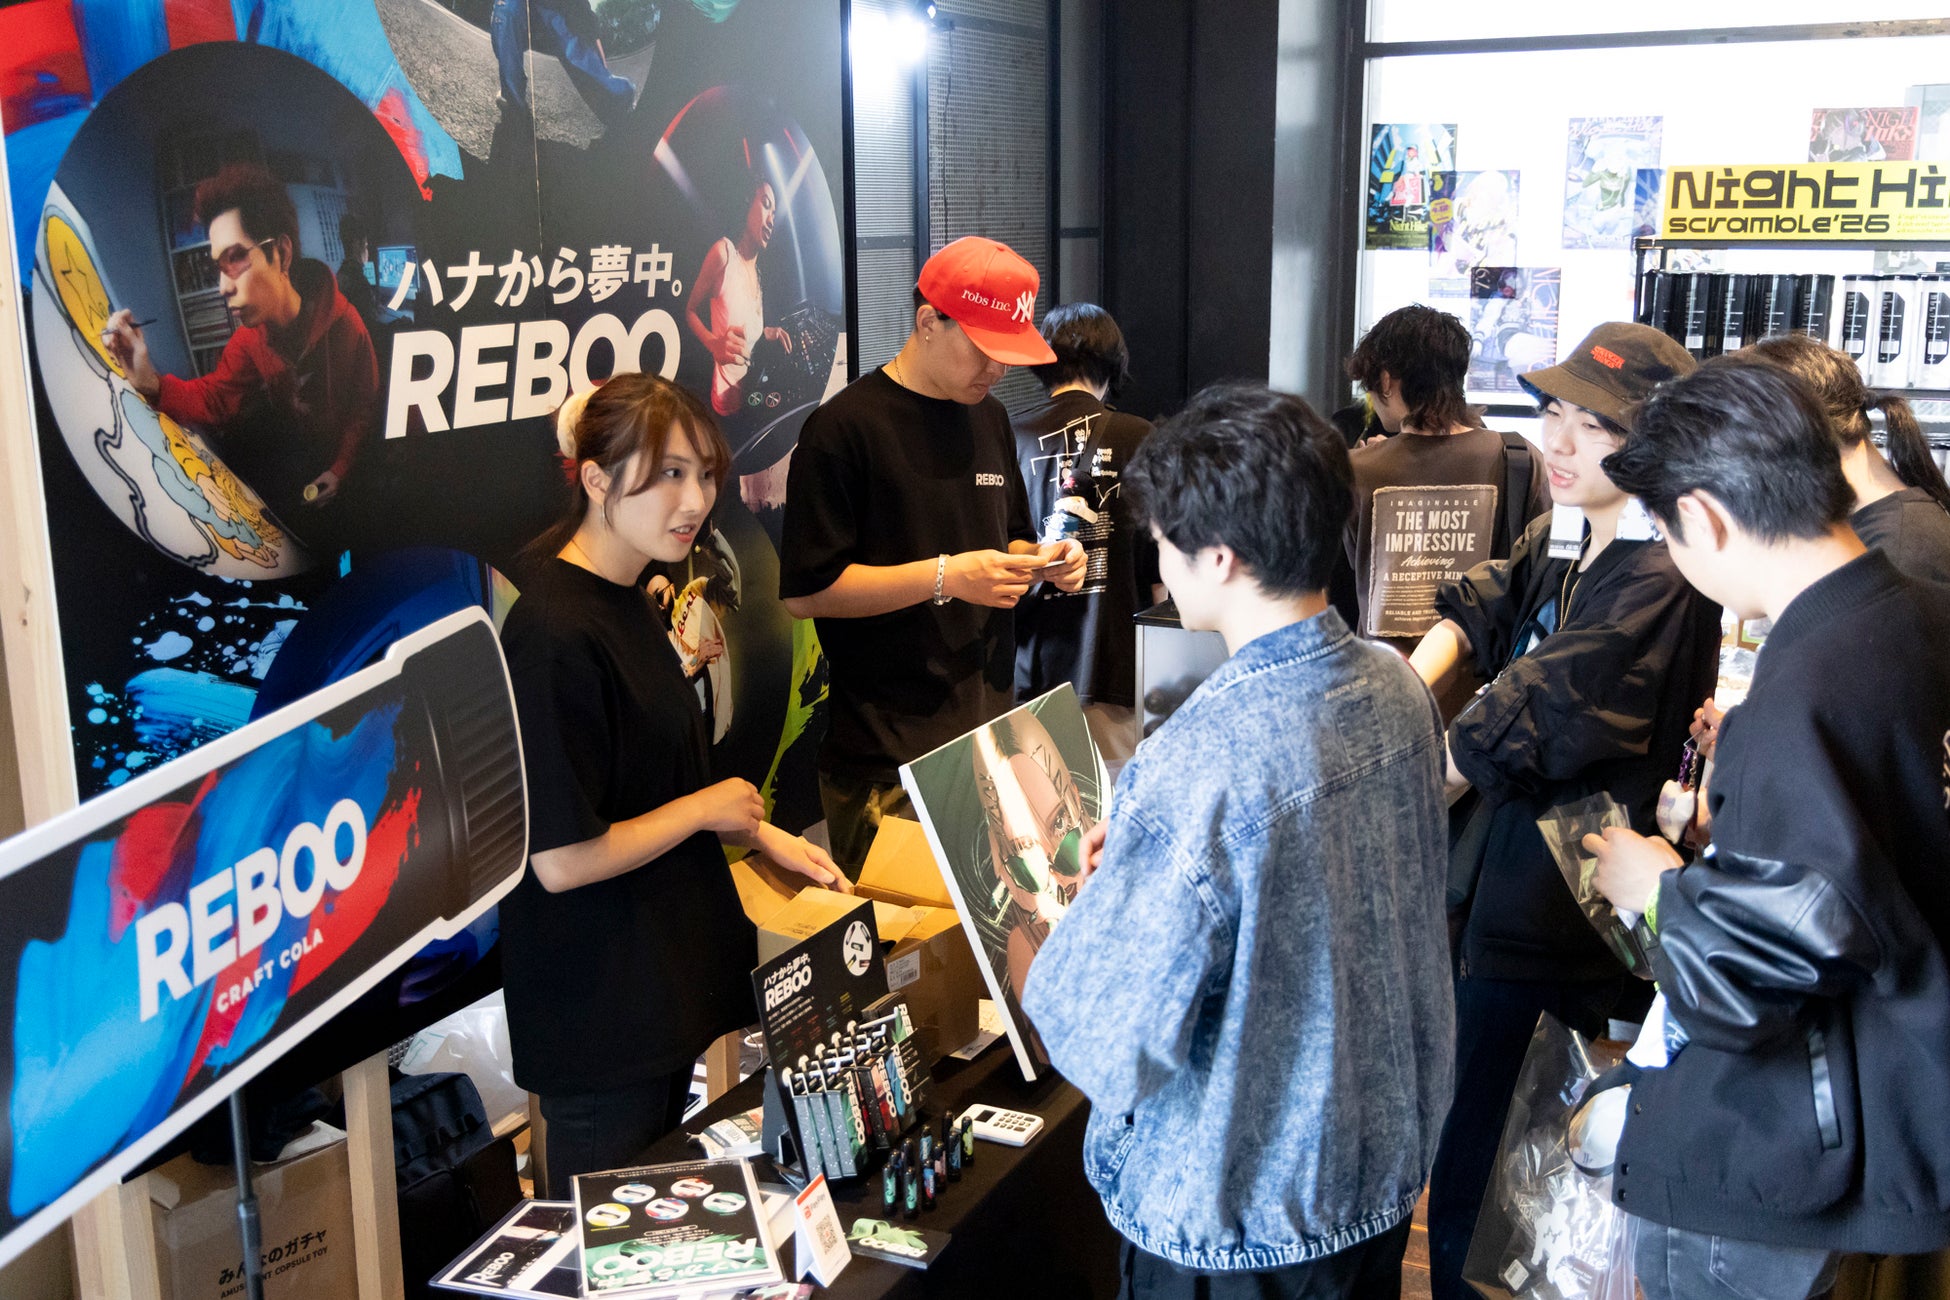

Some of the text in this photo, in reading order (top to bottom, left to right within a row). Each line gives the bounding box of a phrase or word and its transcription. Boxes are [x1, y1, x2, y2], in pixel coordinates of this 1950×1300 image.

[1671, 165, 1950, 209] Night Hi
[1669, 214, 1890, 233] scramble'26
[387, 243, 683, 313] ハナから夢中。
[961, 289, 1011, 311] robs inc.
[975, 473, 1005, 487] REBOO
[1390, 499, 1479, 507] IMAGINABLE
[1396, 510, 1471, 531] THE MOST
[1385, 532, 1477, 553] IMPRESSIVE
[1400, 555, 1456, 570] Achieving
[1383, 570, 1466, 582] A RECEPTIVE MIN
[135, 798, 368, 1024] REBOO
[216, 928, 324, 1014] CRAFT COLA
[764, 965, 813, 1012] REBOO
[891, 1042, 912, 1105] REBOO
[876, 1055, 897, 1118] REBOO
[312, 1246, 328, 1259] TOY
[592, 1237, 758, 1276] REBOO
